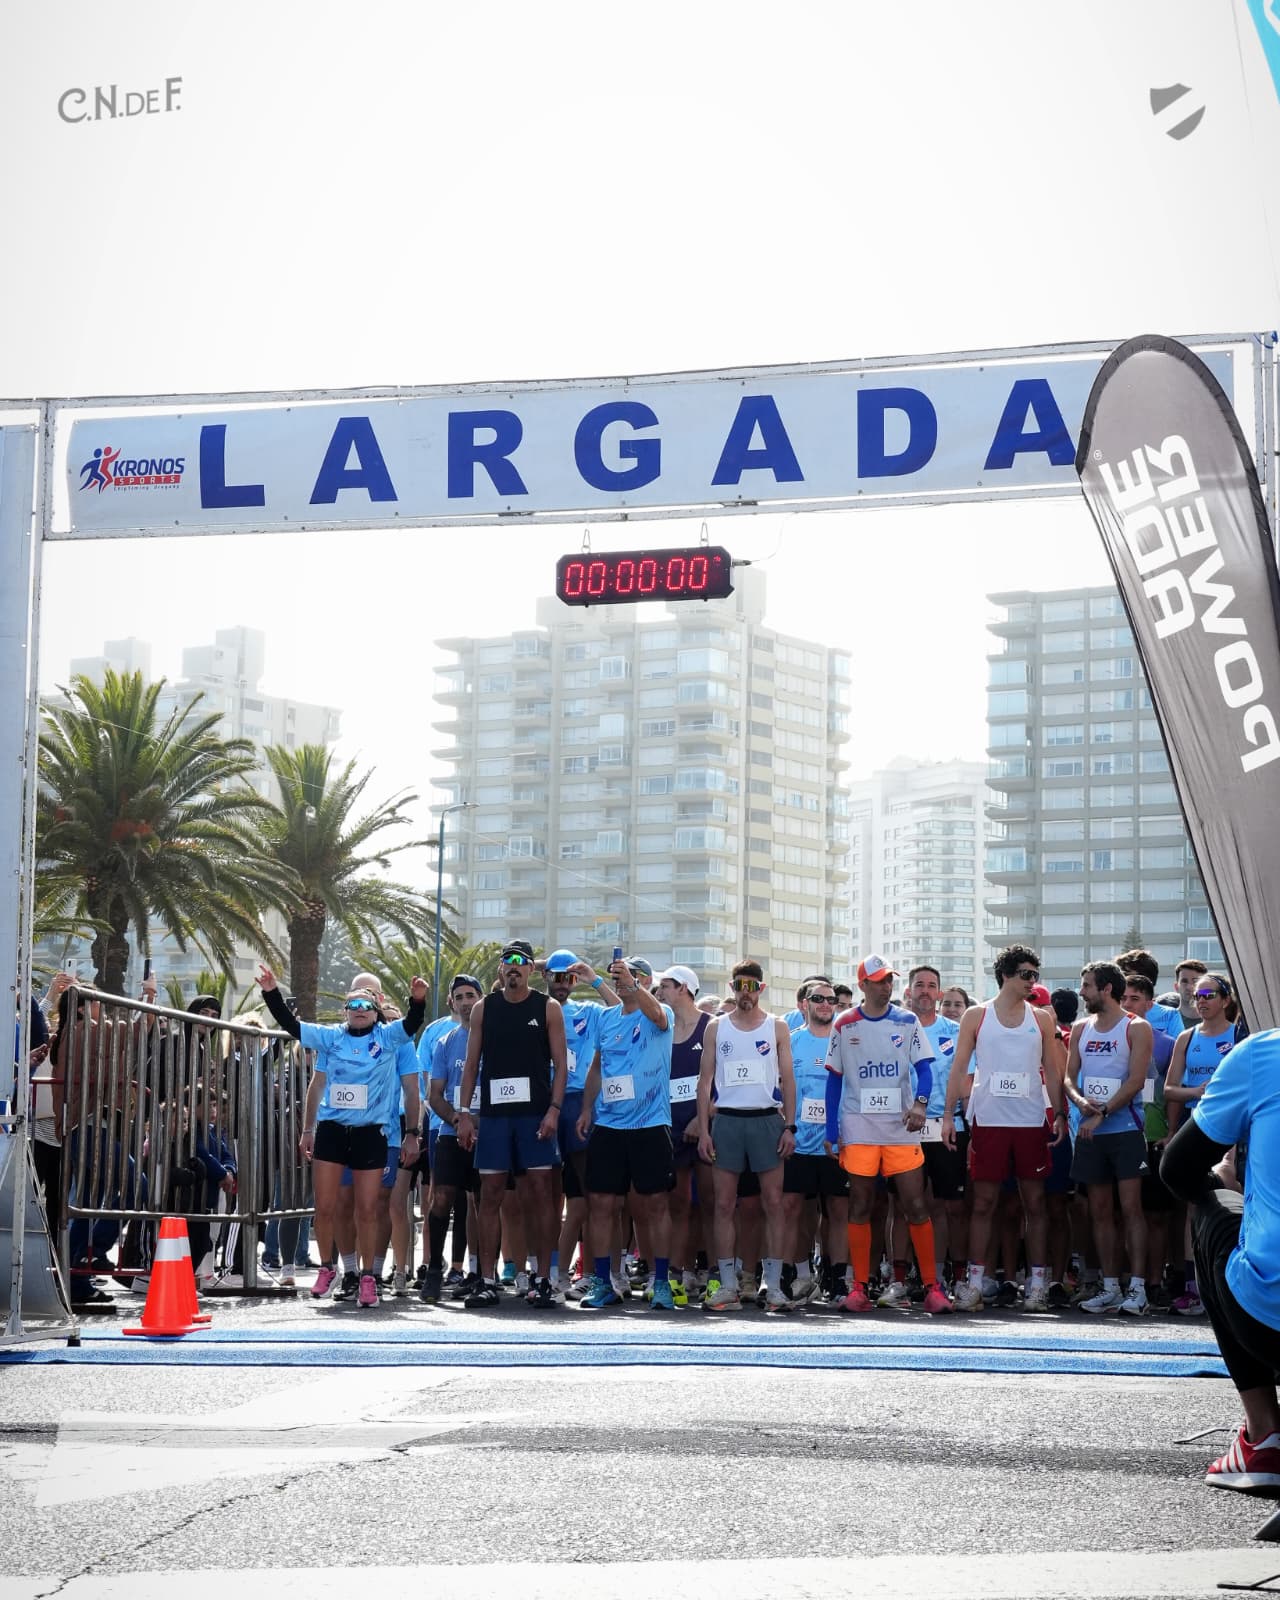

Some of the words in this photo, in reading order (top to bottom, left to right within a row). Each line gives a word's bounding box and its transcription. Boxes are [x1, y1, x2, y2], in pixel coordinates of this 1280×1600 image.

[200, 379, 1077, 509] LARGADA
[113, 457, 185, 477] KRONOS
[119, 476, 176, 485] SPORTS
[565, 557, 708, 595] 00:00:00
[1085, 1040, 1112, 1053] EFA
[736, 1067, 749, 1078] 72
[858, 1060, 900, 1079] antel
[1000, 1079, 1017, 1090] 186
[336, 1091, 355, 1102] 210
[500, 1086, 516, 1096] 128
